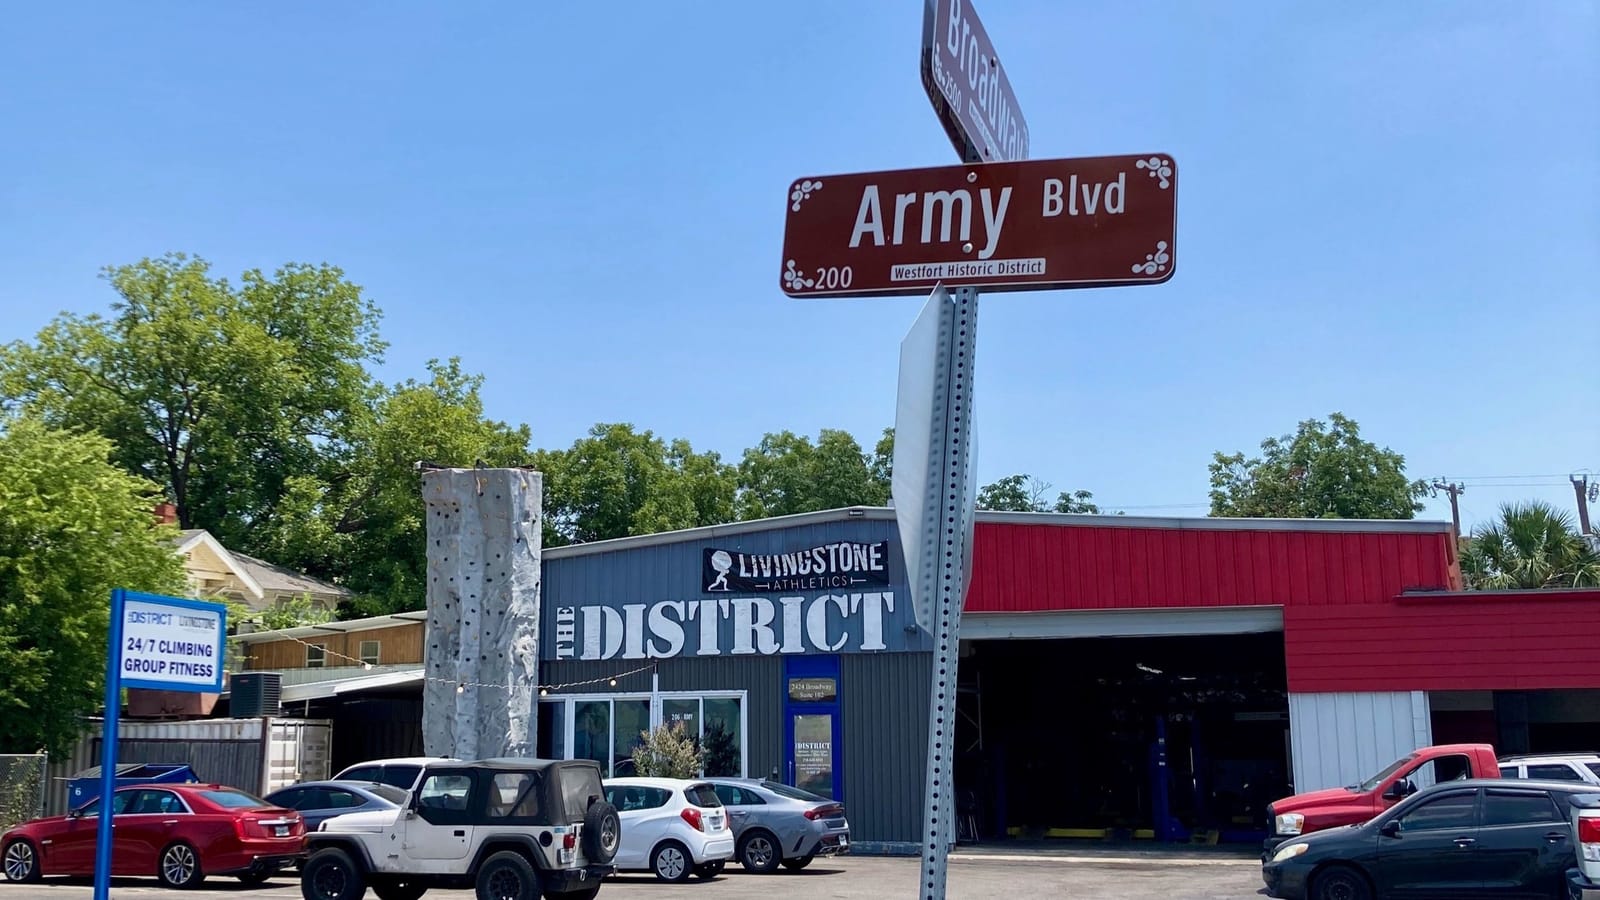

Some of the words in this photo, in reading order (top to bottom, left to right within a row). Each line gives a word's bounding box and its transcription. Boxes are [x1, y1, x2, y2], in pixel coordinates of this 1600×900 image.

[948, 0, 1024, 160] Broadway
[945, 71, 962, 113] 2500
[848, 185, 1013, 260] Army
[1042, 172, 1126, 217] Blvd
[815, 266, 853, 289] 200
[894, 264, 943, 280] Westfort
[947, 261, 993, 277] Historic
[998, 259, 1043, 275] District
[738, 542, 883, 578] LIVINGSTONE
[773, 576, 847, 591] ATHLETICS
[556, 605, 575, 660] THE
[580, 591, 895, 661] DISTRICT
[127, 637, 155, 654] 24/7
[158, 640, 212, 657] CLIMBING
[124, 658, 166, 673] GROUP
[169, 661, 213, 677] FITNESS
[75, 787, 82, 796] 6
